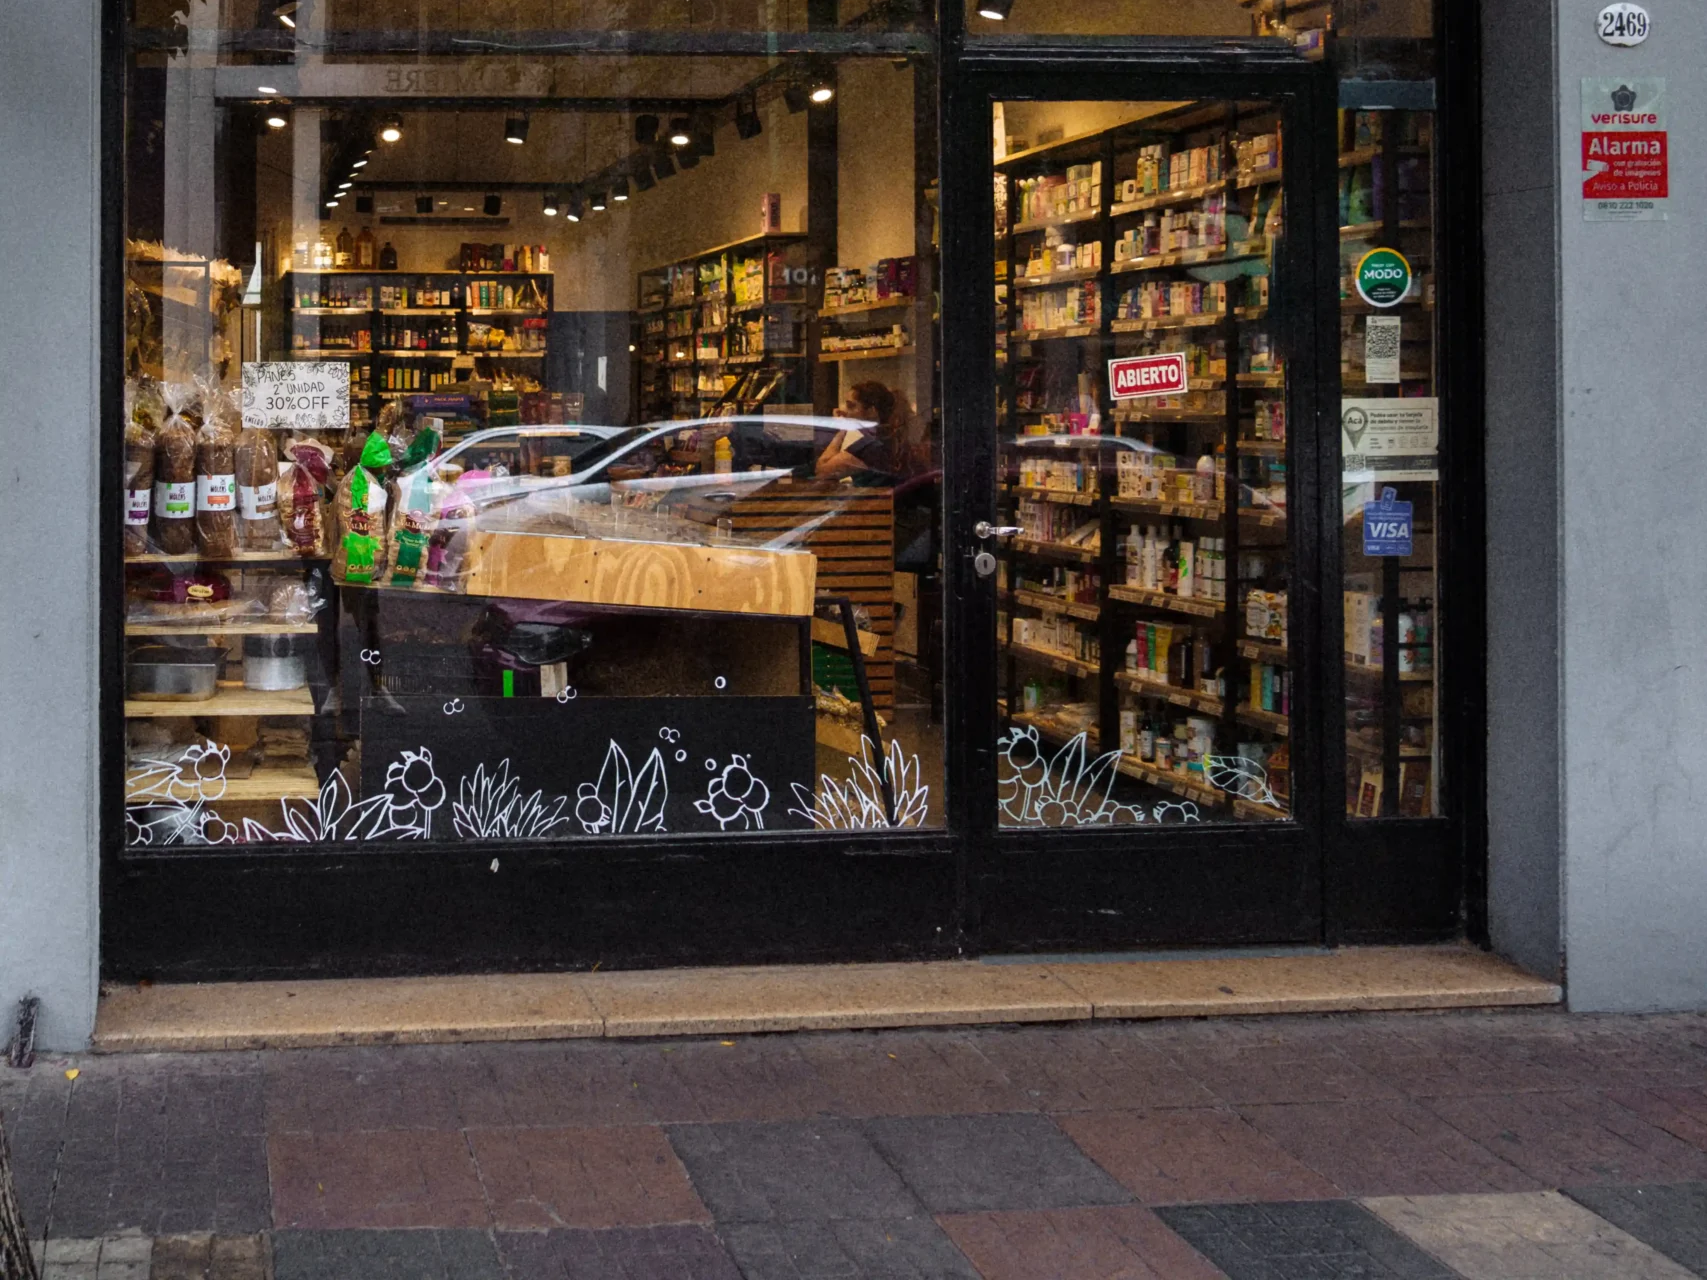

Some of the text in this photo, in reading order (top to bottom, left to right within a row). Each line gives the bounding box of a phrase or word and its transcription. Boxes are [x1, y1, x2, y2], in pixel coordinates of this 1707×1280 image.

[1602, 11, 1647, 38] 2469
[1591, 111, 1657, 125] verisure
[1588, 136, 1661, 156] Alarma
[1613, 169, 1624, 177] de
[1592, 180, 1618, 191] Aviso
[1620, 183, 1626, 191] a
[1619, 201, 1634, 210] 222
[1364, 268, 1404, 280] MODO
[257, 369, 296, 383] PANES
[1117, 364, 1179, 388] ABIERTO
[286, 381, 326, 395] UNIDAD
[1366, 521, 1410, 539] VISA
